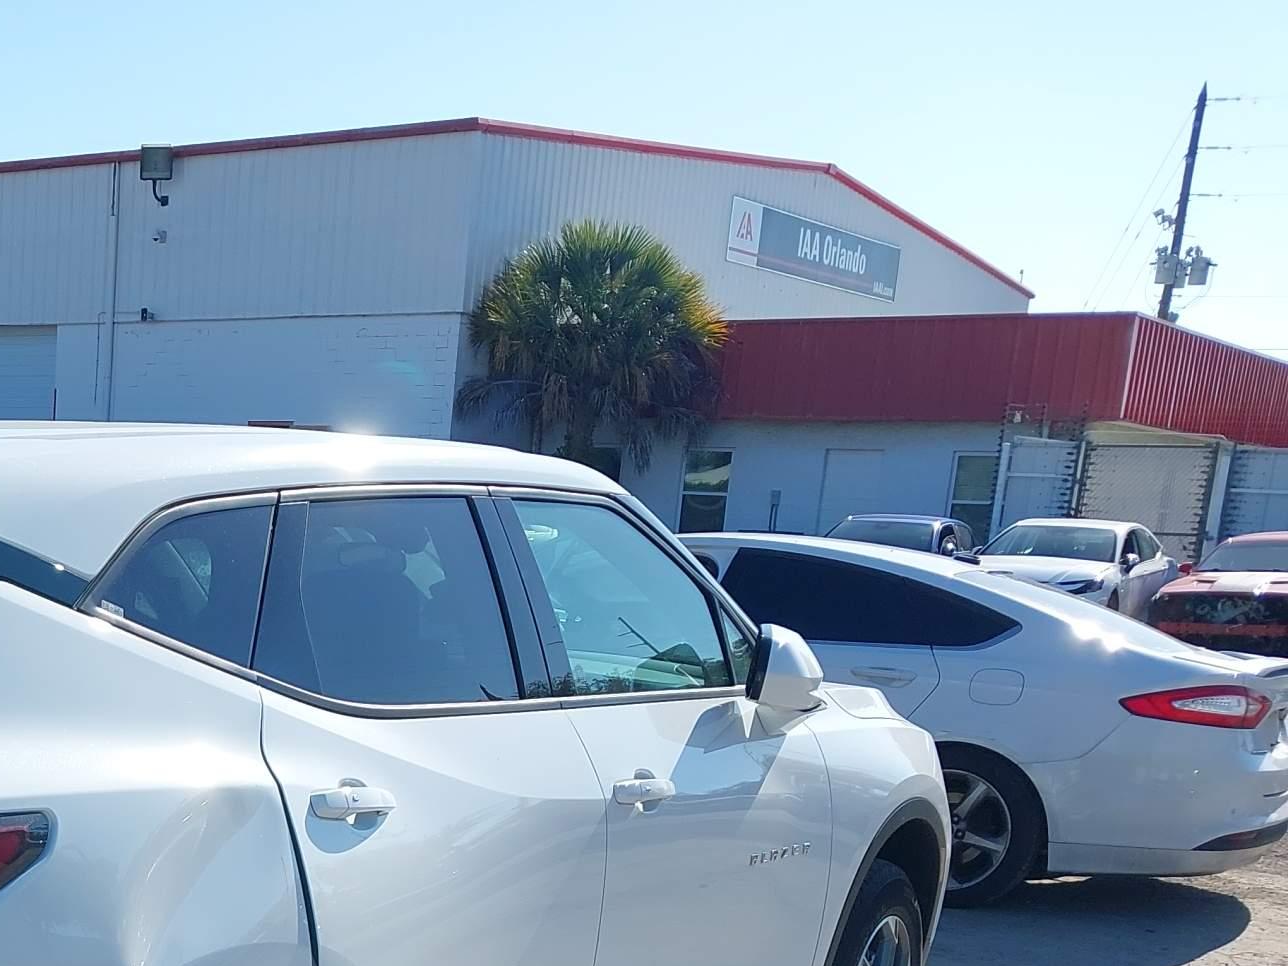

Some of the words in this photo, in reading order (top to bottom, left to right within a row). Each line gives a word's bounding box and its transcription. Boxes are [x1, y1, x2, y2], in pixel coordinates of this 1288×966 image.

[797, 227, 819, 262] IAA
[823, 234, 867, 275] Orlando
[749, 842, 811, 866] BLAZER
